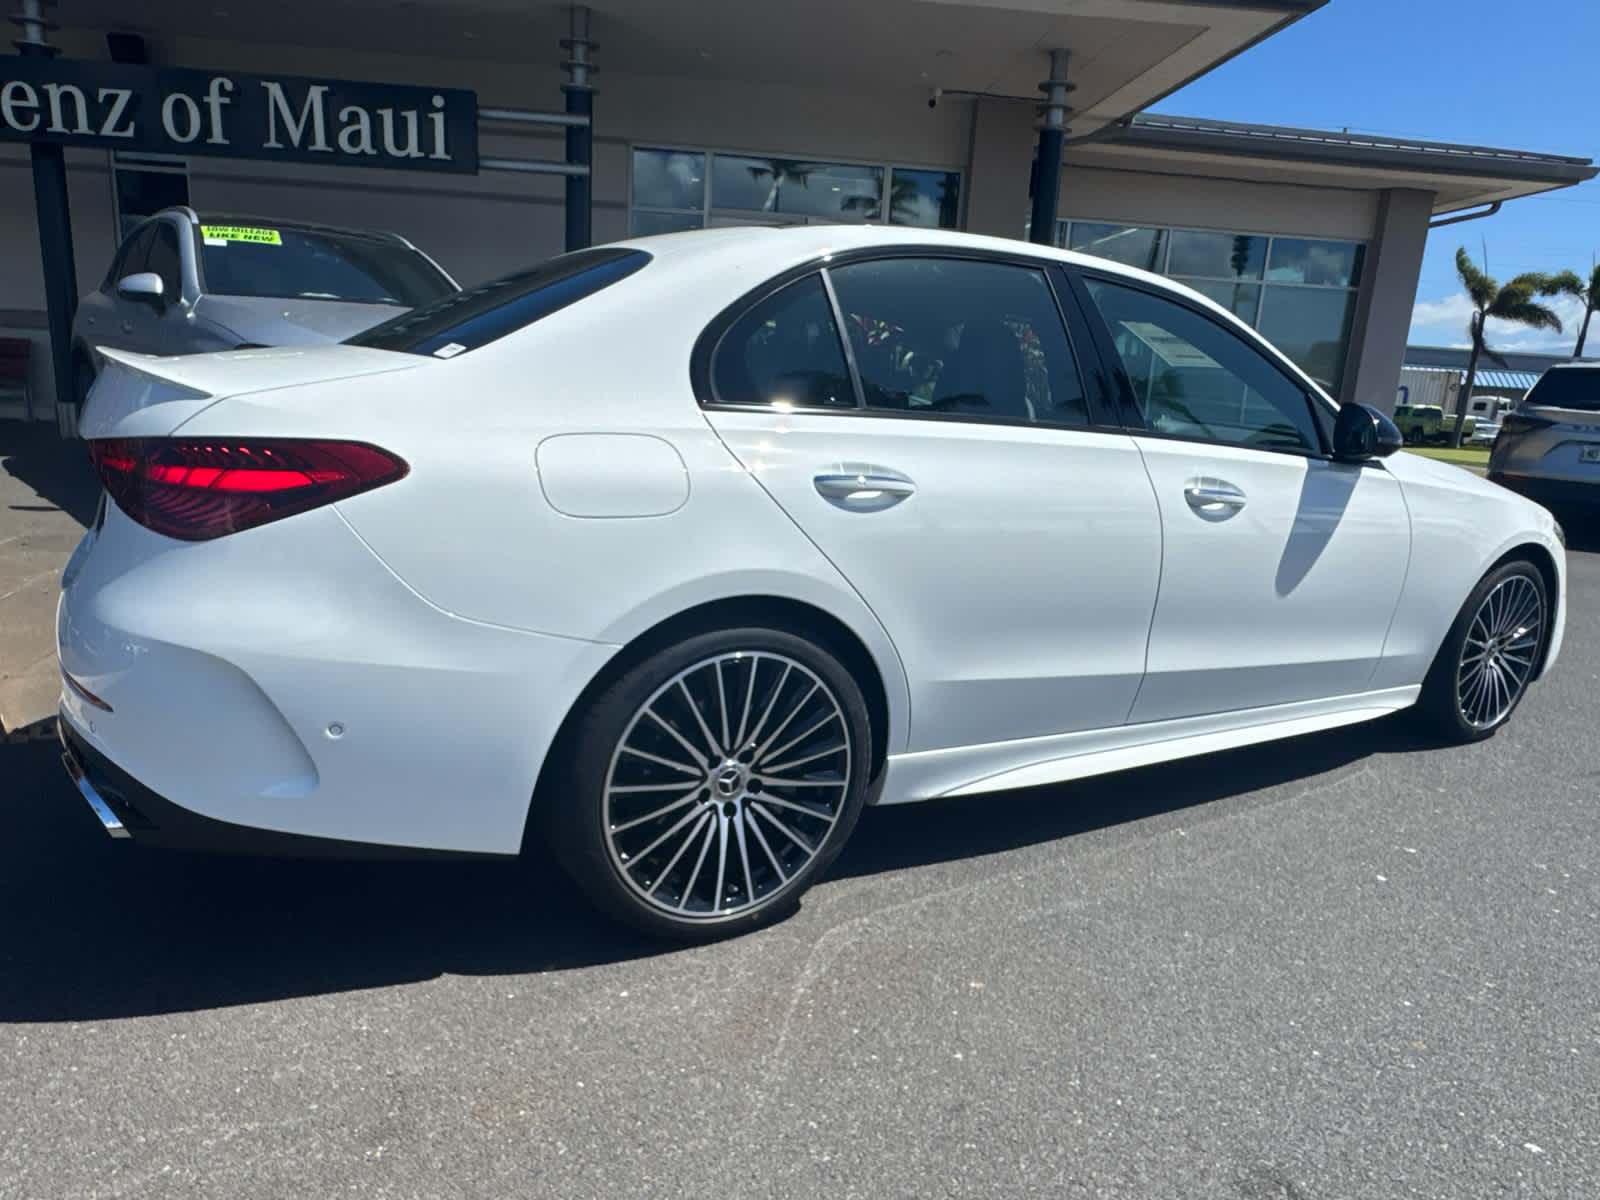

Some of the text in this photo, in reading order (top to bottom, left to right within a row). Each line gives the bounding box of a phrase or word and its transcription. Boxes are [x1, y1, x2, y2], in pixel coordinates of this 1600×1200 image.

[162, 77, 234, 145] of
[260, 81, 452, 160] Maui
[243, 233, 274, 242] NEW
